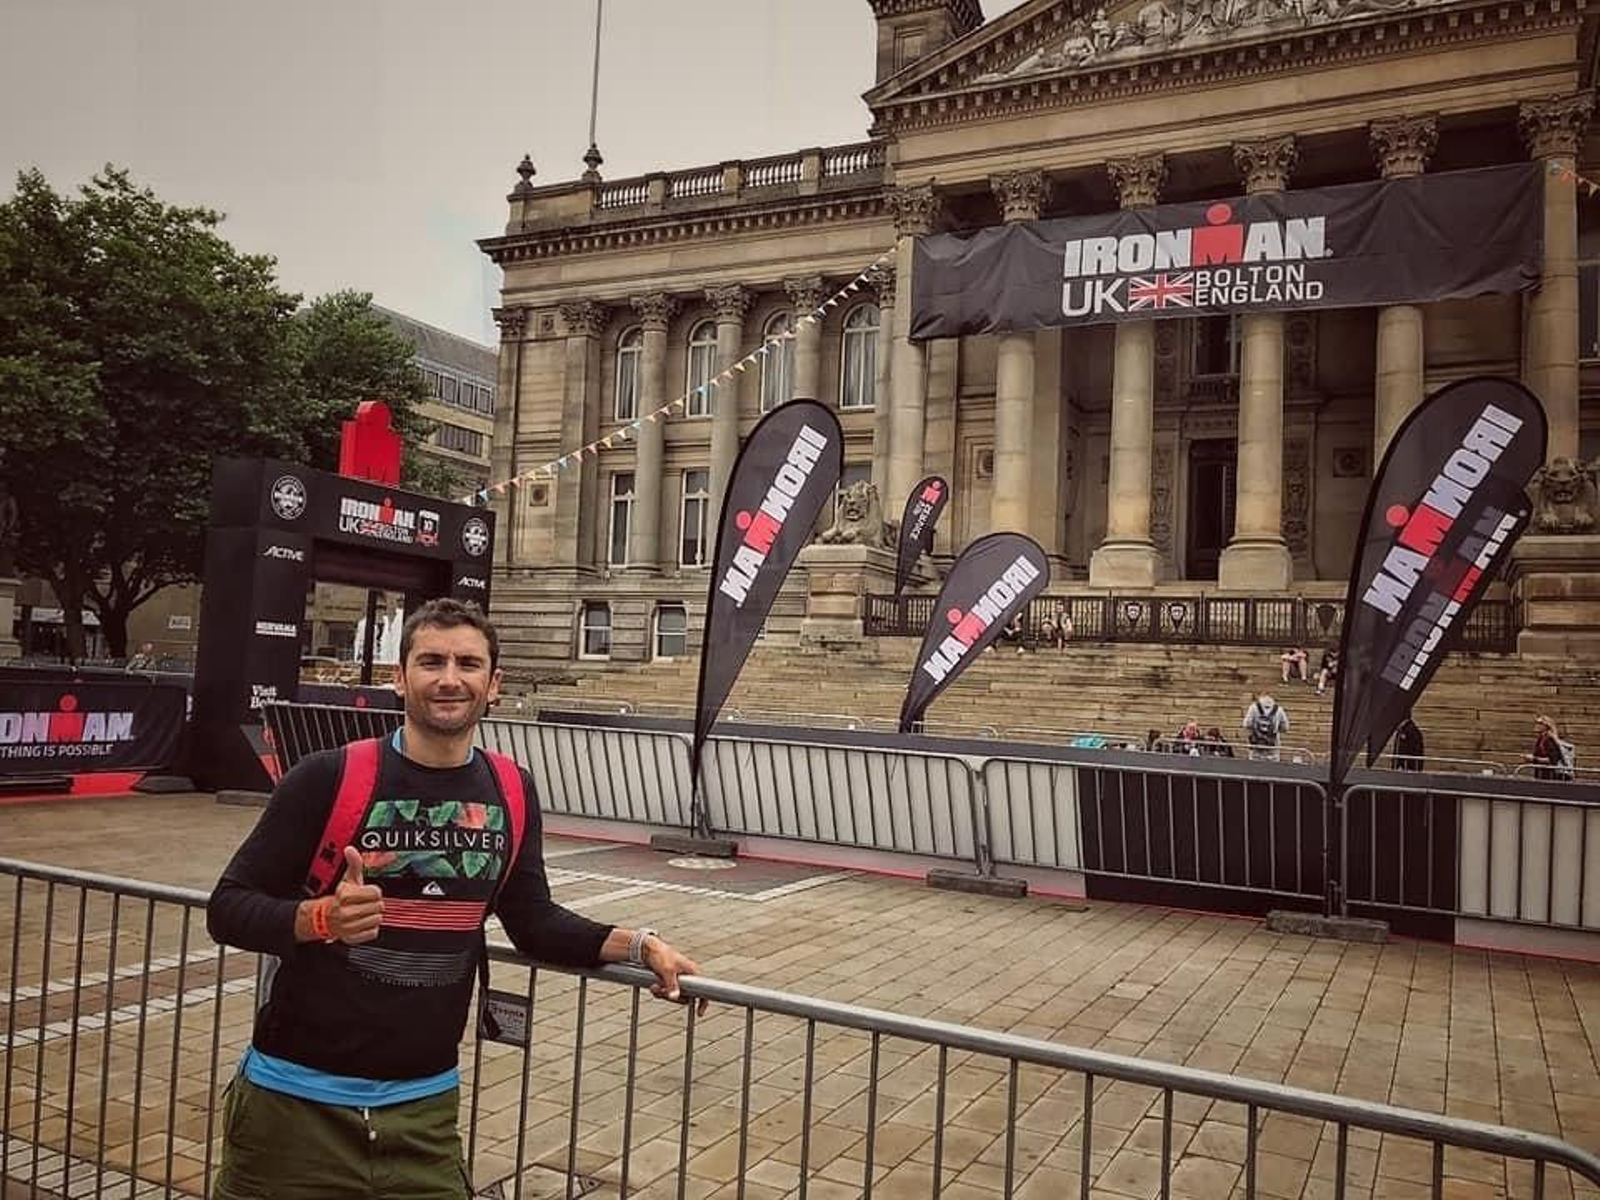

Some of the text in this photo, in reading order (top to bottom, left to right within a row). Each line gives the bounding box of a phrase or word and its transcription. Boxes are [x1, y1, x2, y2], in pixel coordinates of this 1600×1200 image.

[1064, 205, 1333, 277] IRONMAN
[1195, 264, 1306, 288] BOLTON
[1062, 277, 1126, 317] UK
[1195, 281, 1324, 307] ENGLAND
[339, 516, 359, 534] UK
[340, 497, 417, 530] IRONMAN
[264, 545, 304, 562] ACTIVE
[43, 744, 56, 757] IS
[58, 744, 114, 757] POSSIBLE
[361, 830, 505, 850] QUIKSILVER
